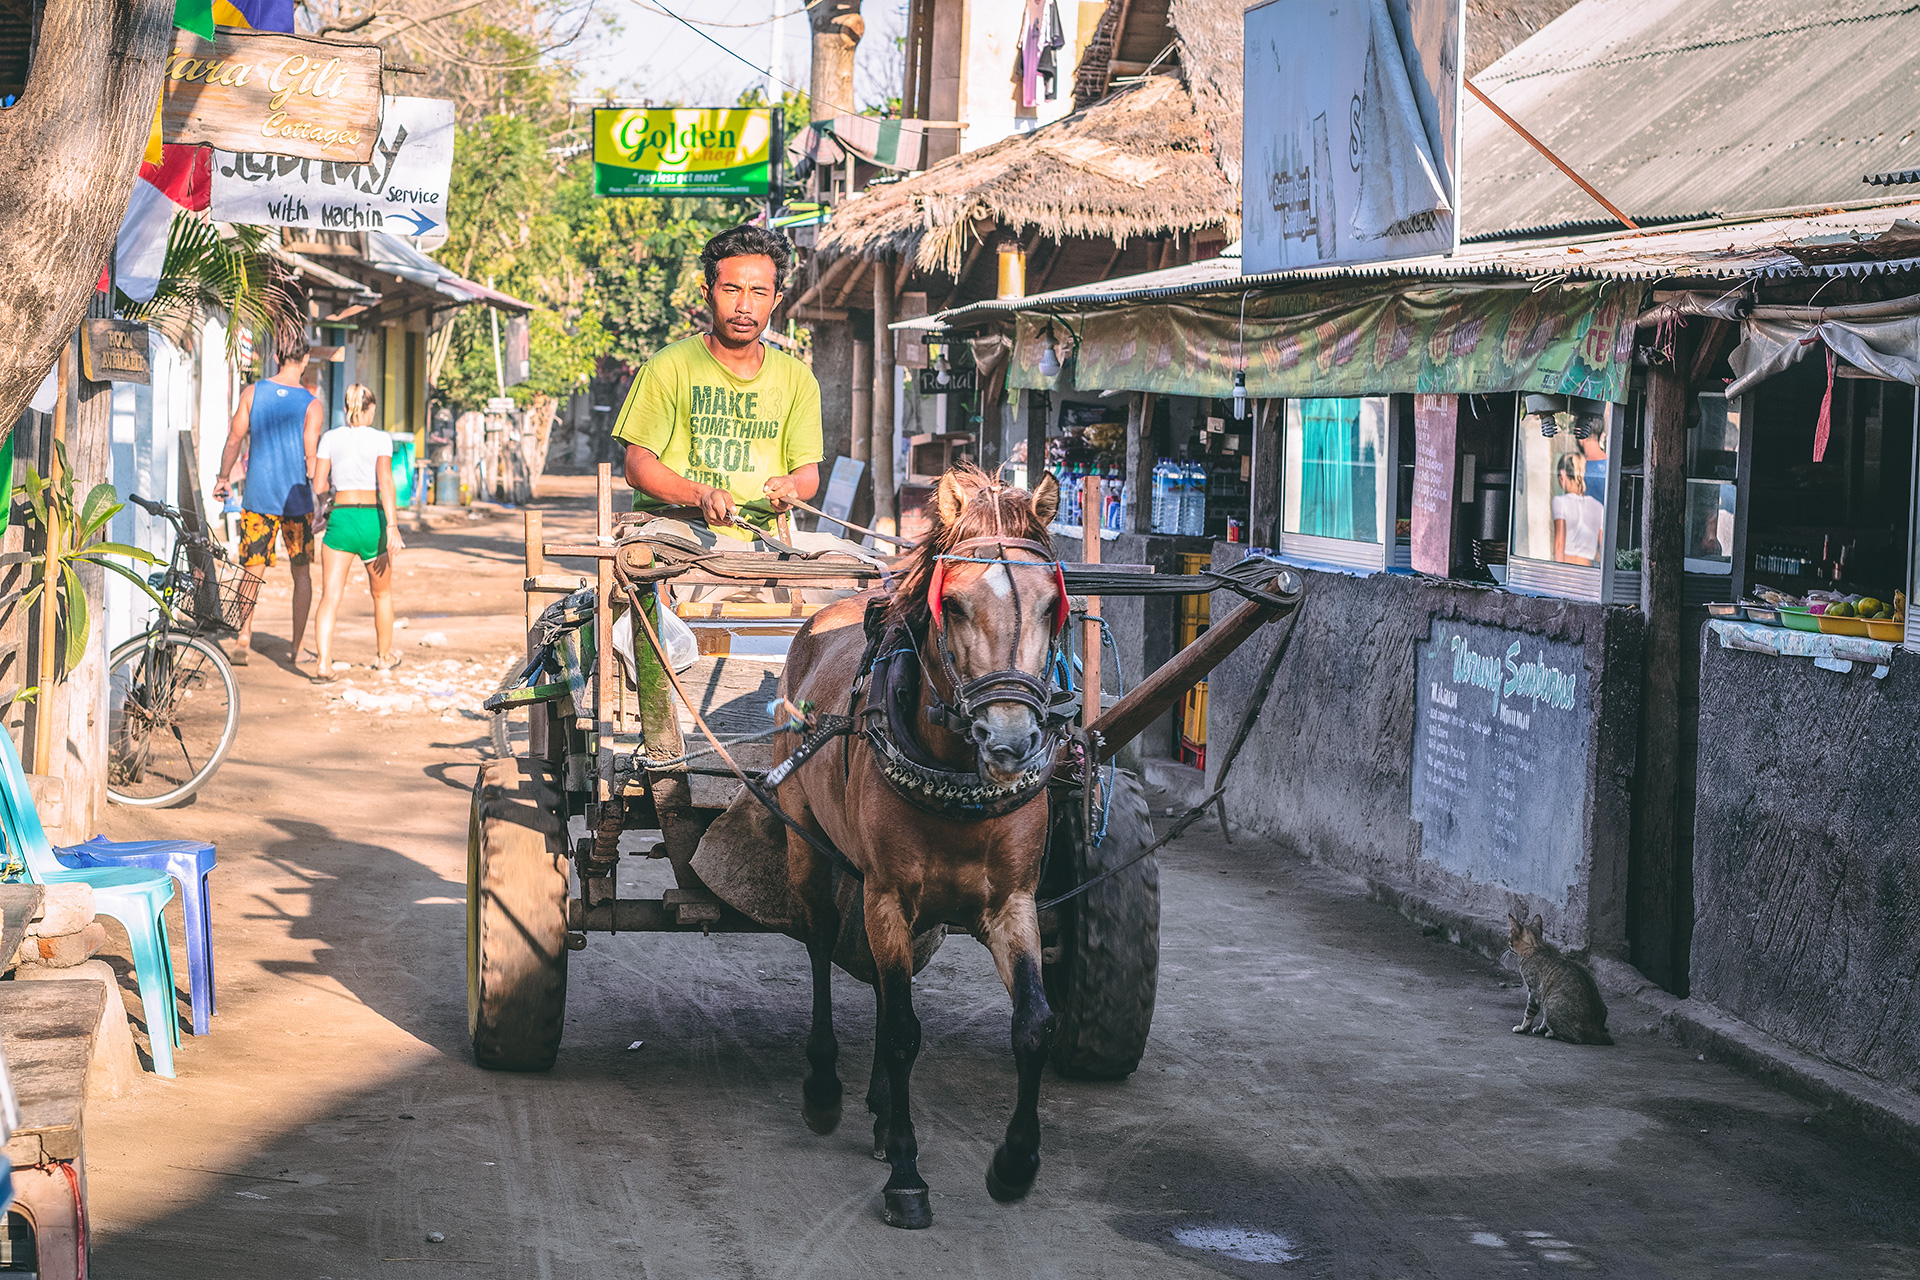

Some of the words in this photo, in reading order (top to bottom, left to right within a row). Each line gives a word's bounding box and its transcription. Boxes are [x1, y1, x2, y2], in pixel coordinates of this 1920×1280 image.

[165, 47, 254, 88] iara
[268, 54, 350, 111] Gili
[261, 111, 361, 151] Cottages
[620, 116, 736, 163] Golden
[657, 171, 677, 183] less
[676, 172, 693, 185] get
[267, 194, 309, 222] with
[107, 330, 133, 349] ROOM
[101, 351, 144, 373] AVAILABLE
[690, 385, 758, 420] MAKE
[689, 416, 779, 440] SOMETHING
[688, 436, 755, 472] COOL
[1504, 640, 1577, 713] Sempurna
